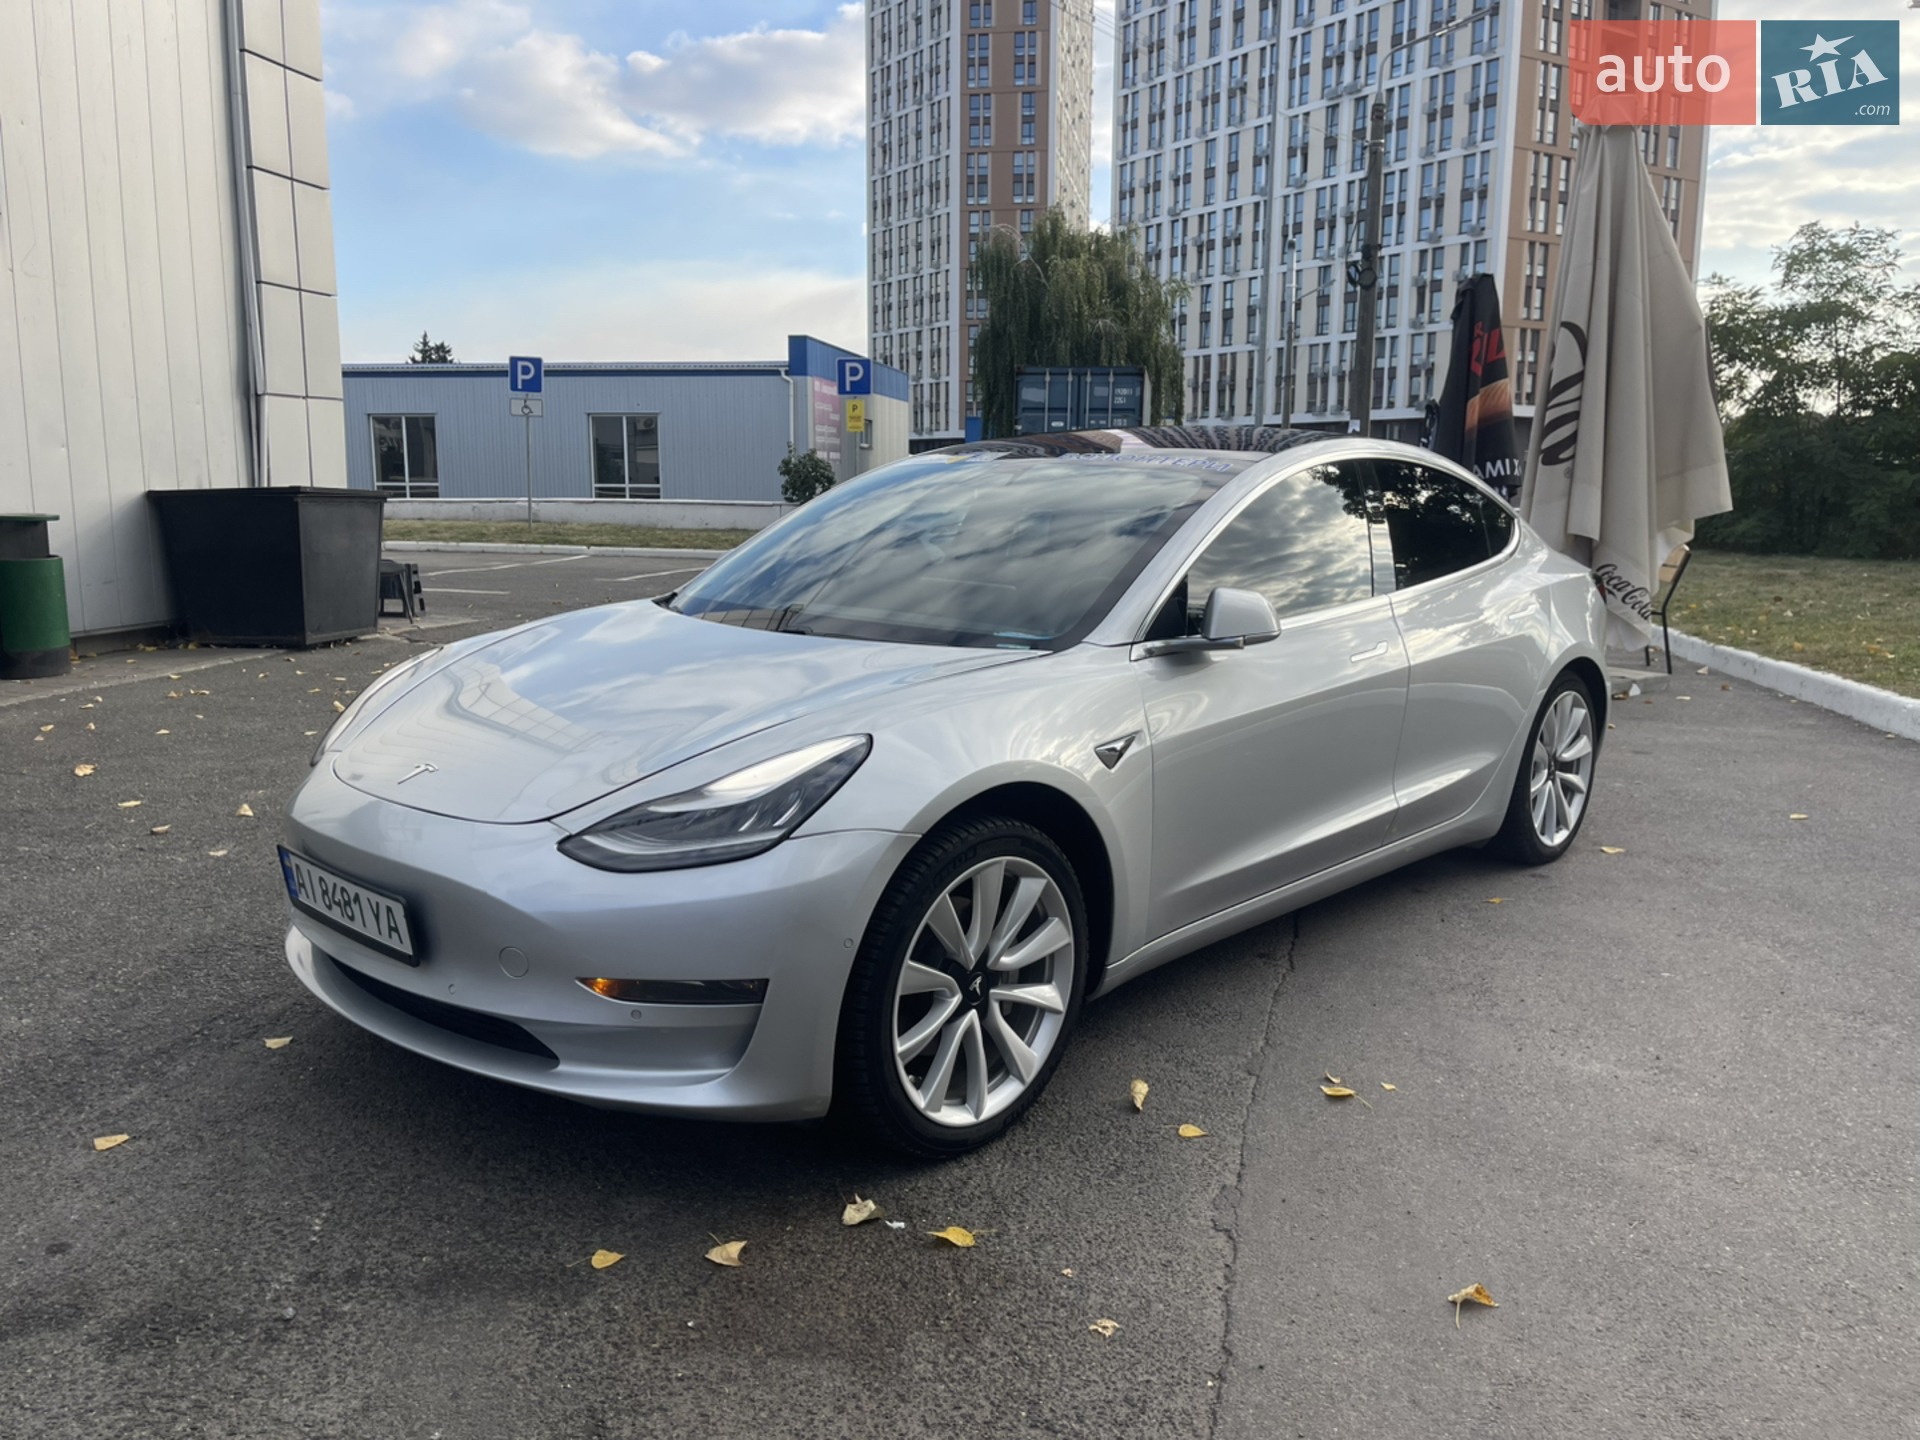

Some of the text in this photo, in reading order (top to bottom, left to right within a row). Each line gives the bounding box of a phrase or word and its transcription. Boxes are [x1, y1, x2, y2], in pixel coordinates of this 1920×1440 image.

[517, 360, 535, 389] P
[844, 361, 864, 392] P
[294, 863, 404, 945] AI 8481 YA
